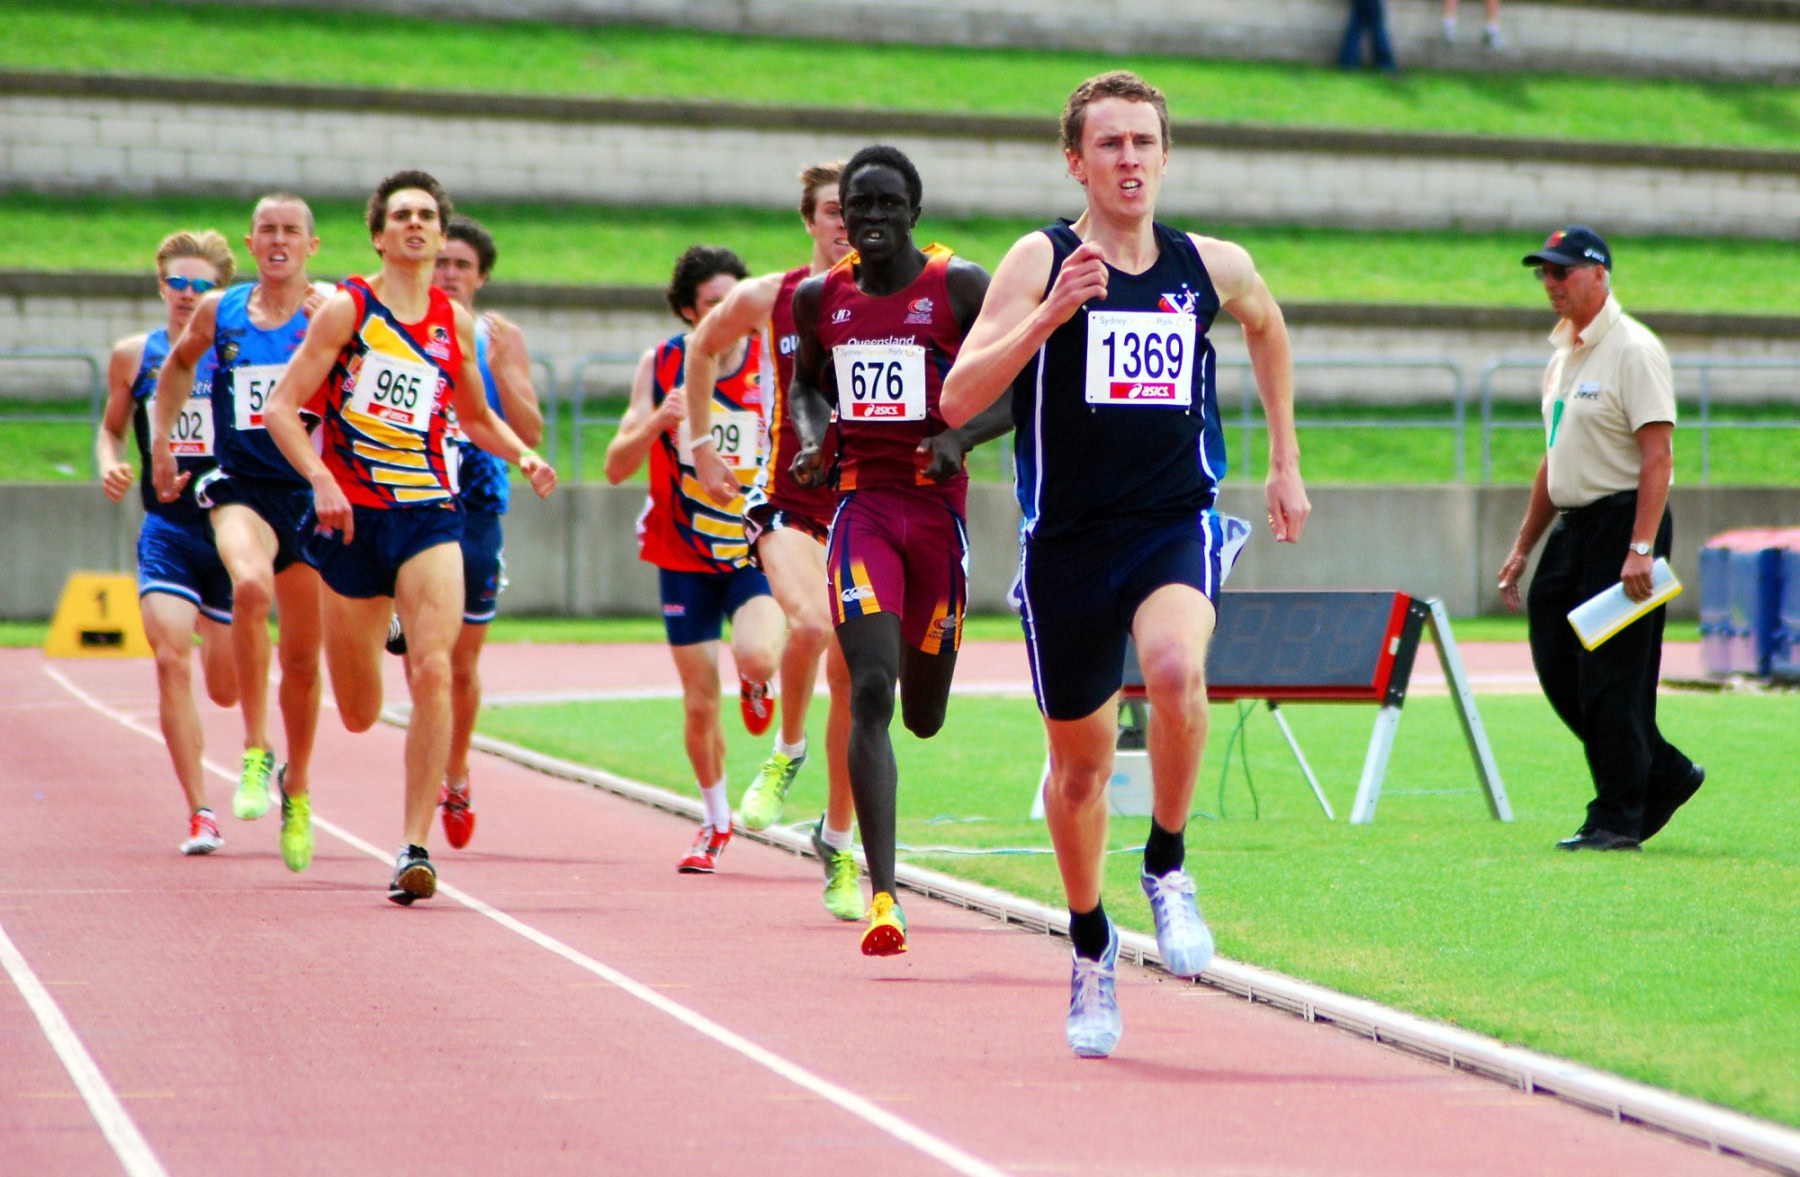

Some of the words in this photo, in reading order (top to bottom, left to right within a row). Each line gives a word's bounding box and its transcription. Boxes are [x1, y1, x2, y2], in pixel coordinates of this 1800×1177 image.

[1102, 331, 1184, 380] 1369
[373, 369, 422, 409] 965
[851, 361, 904, 401] 676
[171, 411, 203, 440] 02
[710, 424, 740, 453] 09
[95, 589, 108, 619] 1
